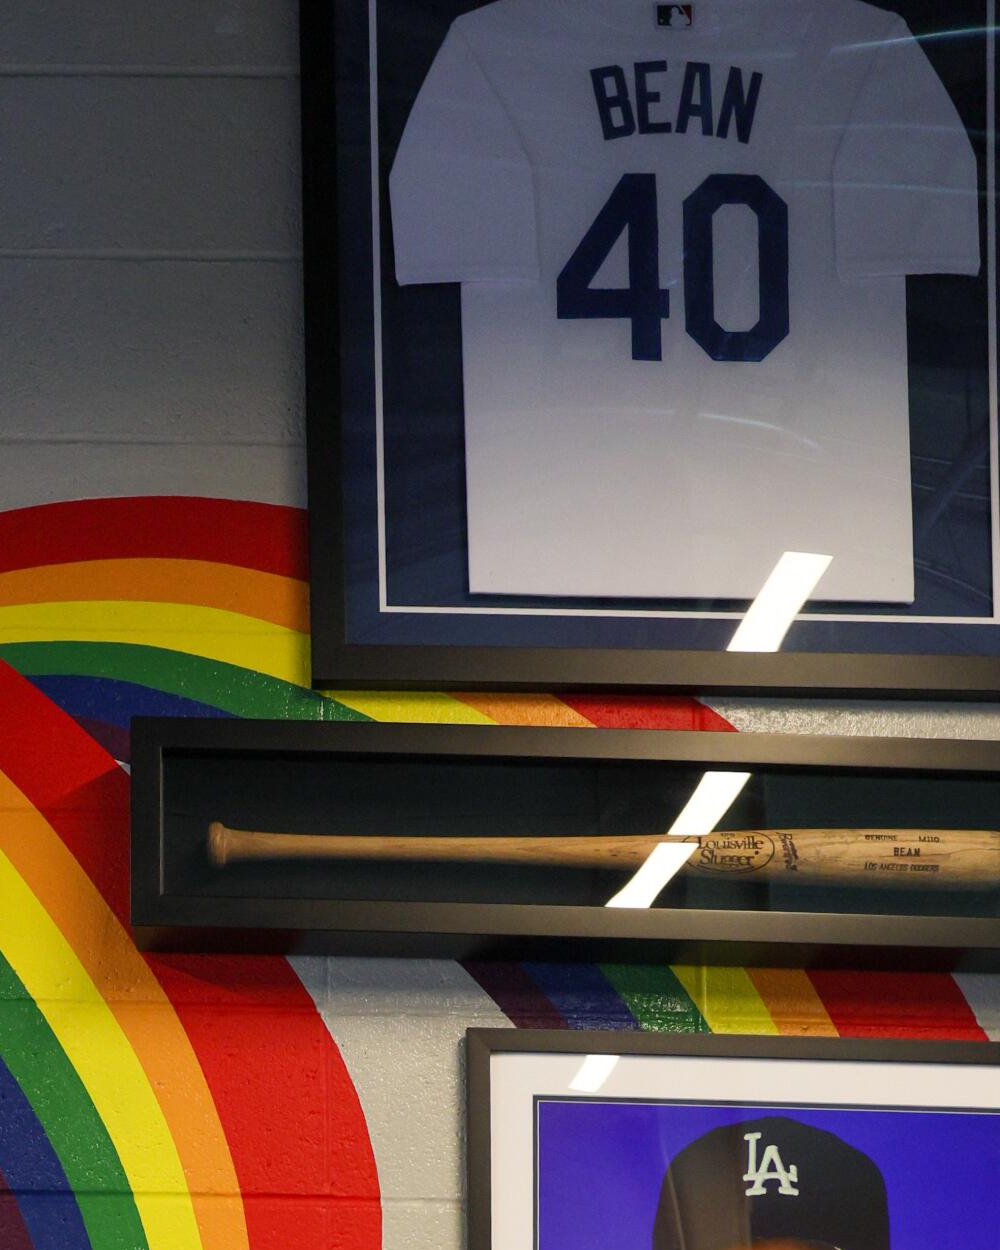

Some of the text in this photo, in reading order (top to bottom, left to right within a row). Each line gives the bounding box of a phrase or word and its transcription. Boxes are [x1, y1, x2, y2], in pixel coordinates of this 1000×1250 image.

[589, 60, 763, 144] BEAN
[557, 172, 789, 362] 40
[696, 836, 764, 850] Louisville
[699, 849, 756, 866] Slugger
[893, 847, 921, 857] BEAN
[864, 862, 877, 871] LOS
[743, 1131, 799, 1197] LA
